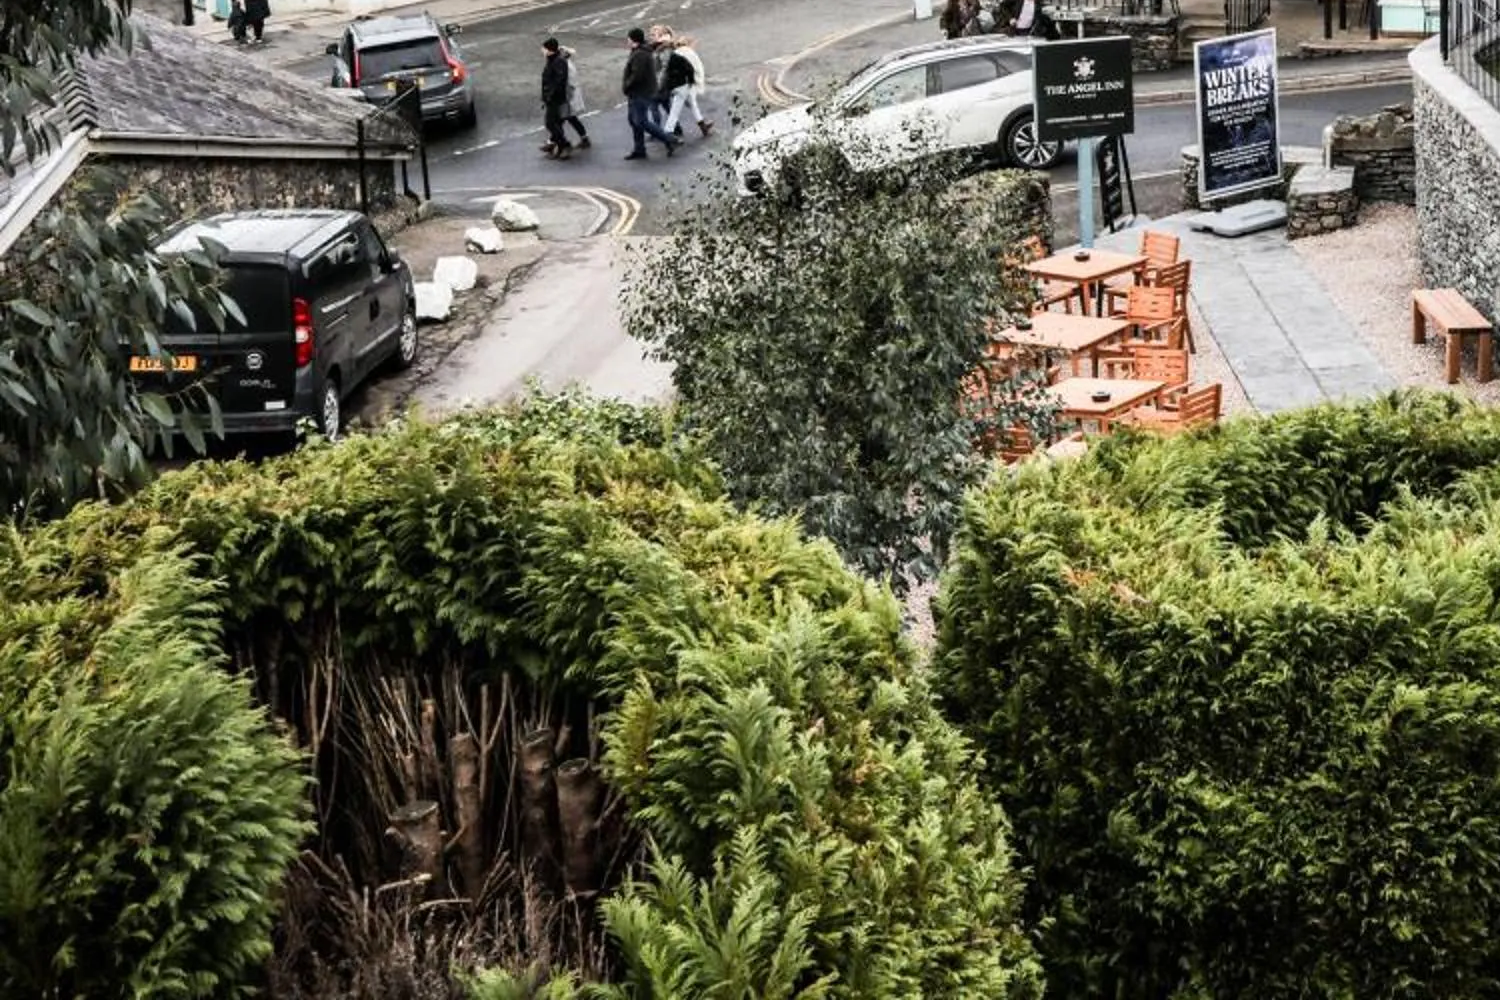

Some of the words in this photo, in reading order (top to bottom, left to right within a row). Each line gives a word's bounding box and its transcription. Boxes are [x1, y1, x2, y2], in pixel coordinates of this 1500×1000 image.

[1044, 85, 1067, 96] THE
[1068, 81, 1104, 95] ANGEL
[1104, 80, 1125, 92] INN
[1204, 63, 1270, 89] WINTER
[1207, 78, 1270, 107] BREAKS
